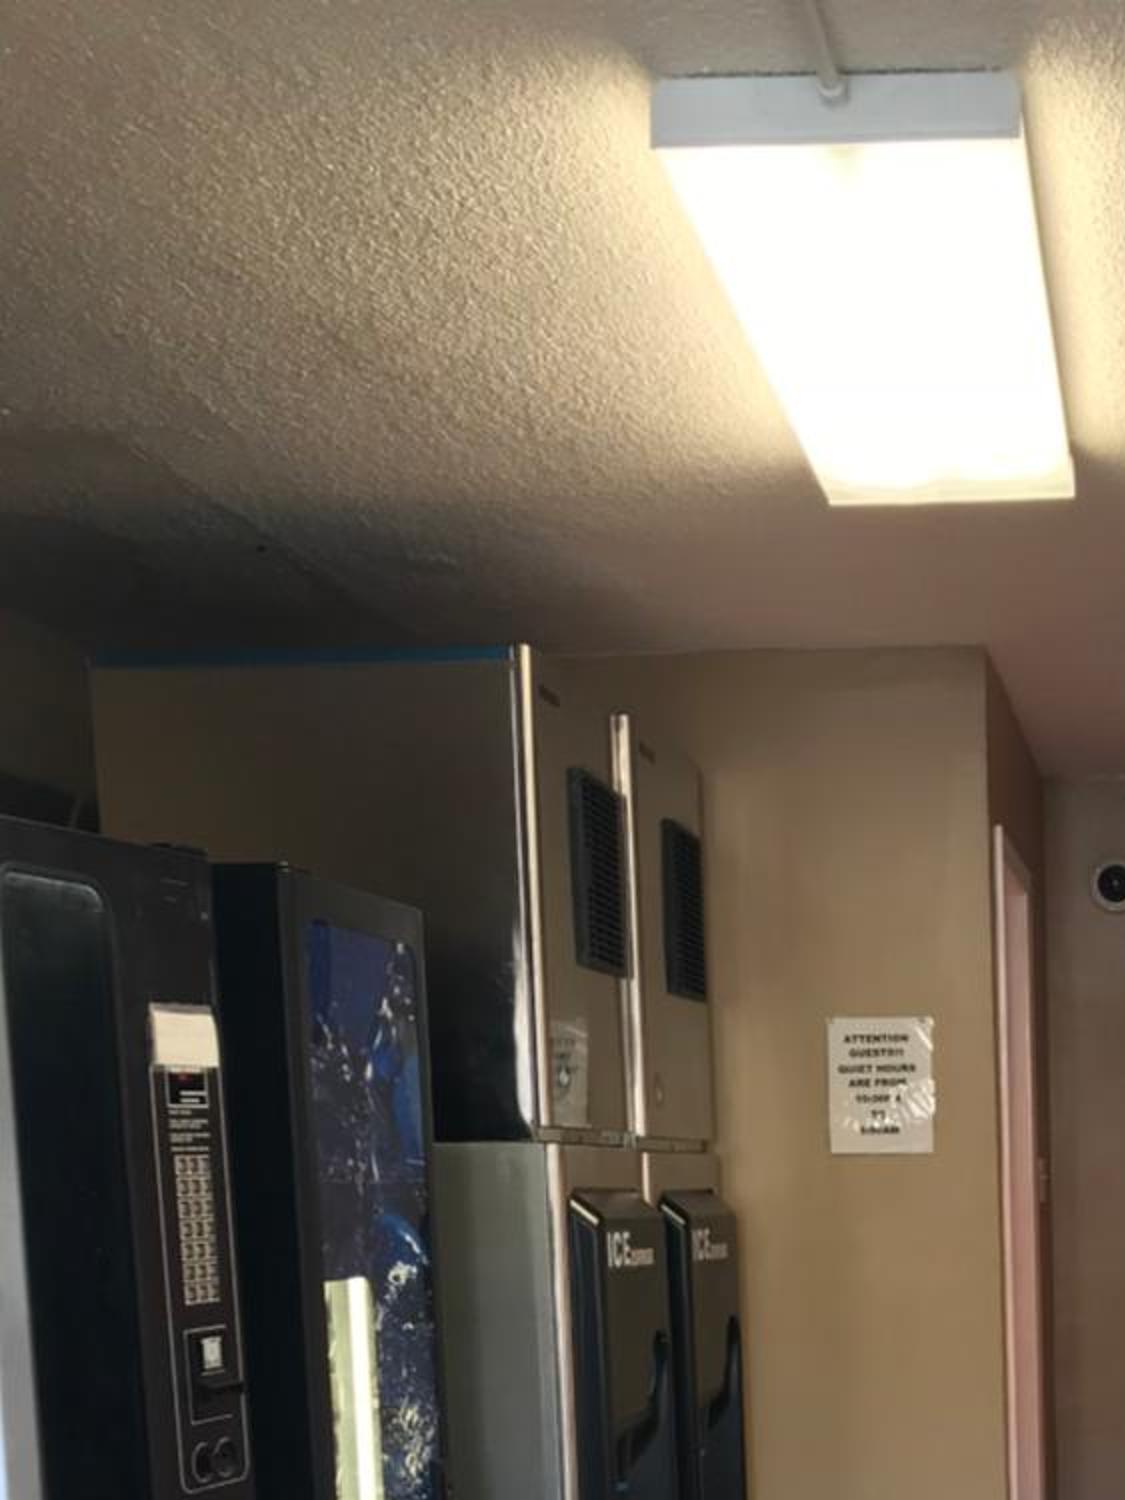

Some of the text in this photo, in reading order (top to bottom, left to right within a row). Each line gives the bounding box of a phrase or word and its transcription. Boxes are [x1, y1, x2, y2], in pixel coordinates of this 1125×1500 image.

[843, 1034, 909, 1044] ATTENTION
[837, 1064, 916, 1074] QUIET HOURS
[848, 1077, 907, 1088] ARE FROM
[607, 1231, 631, 1268] ICE
